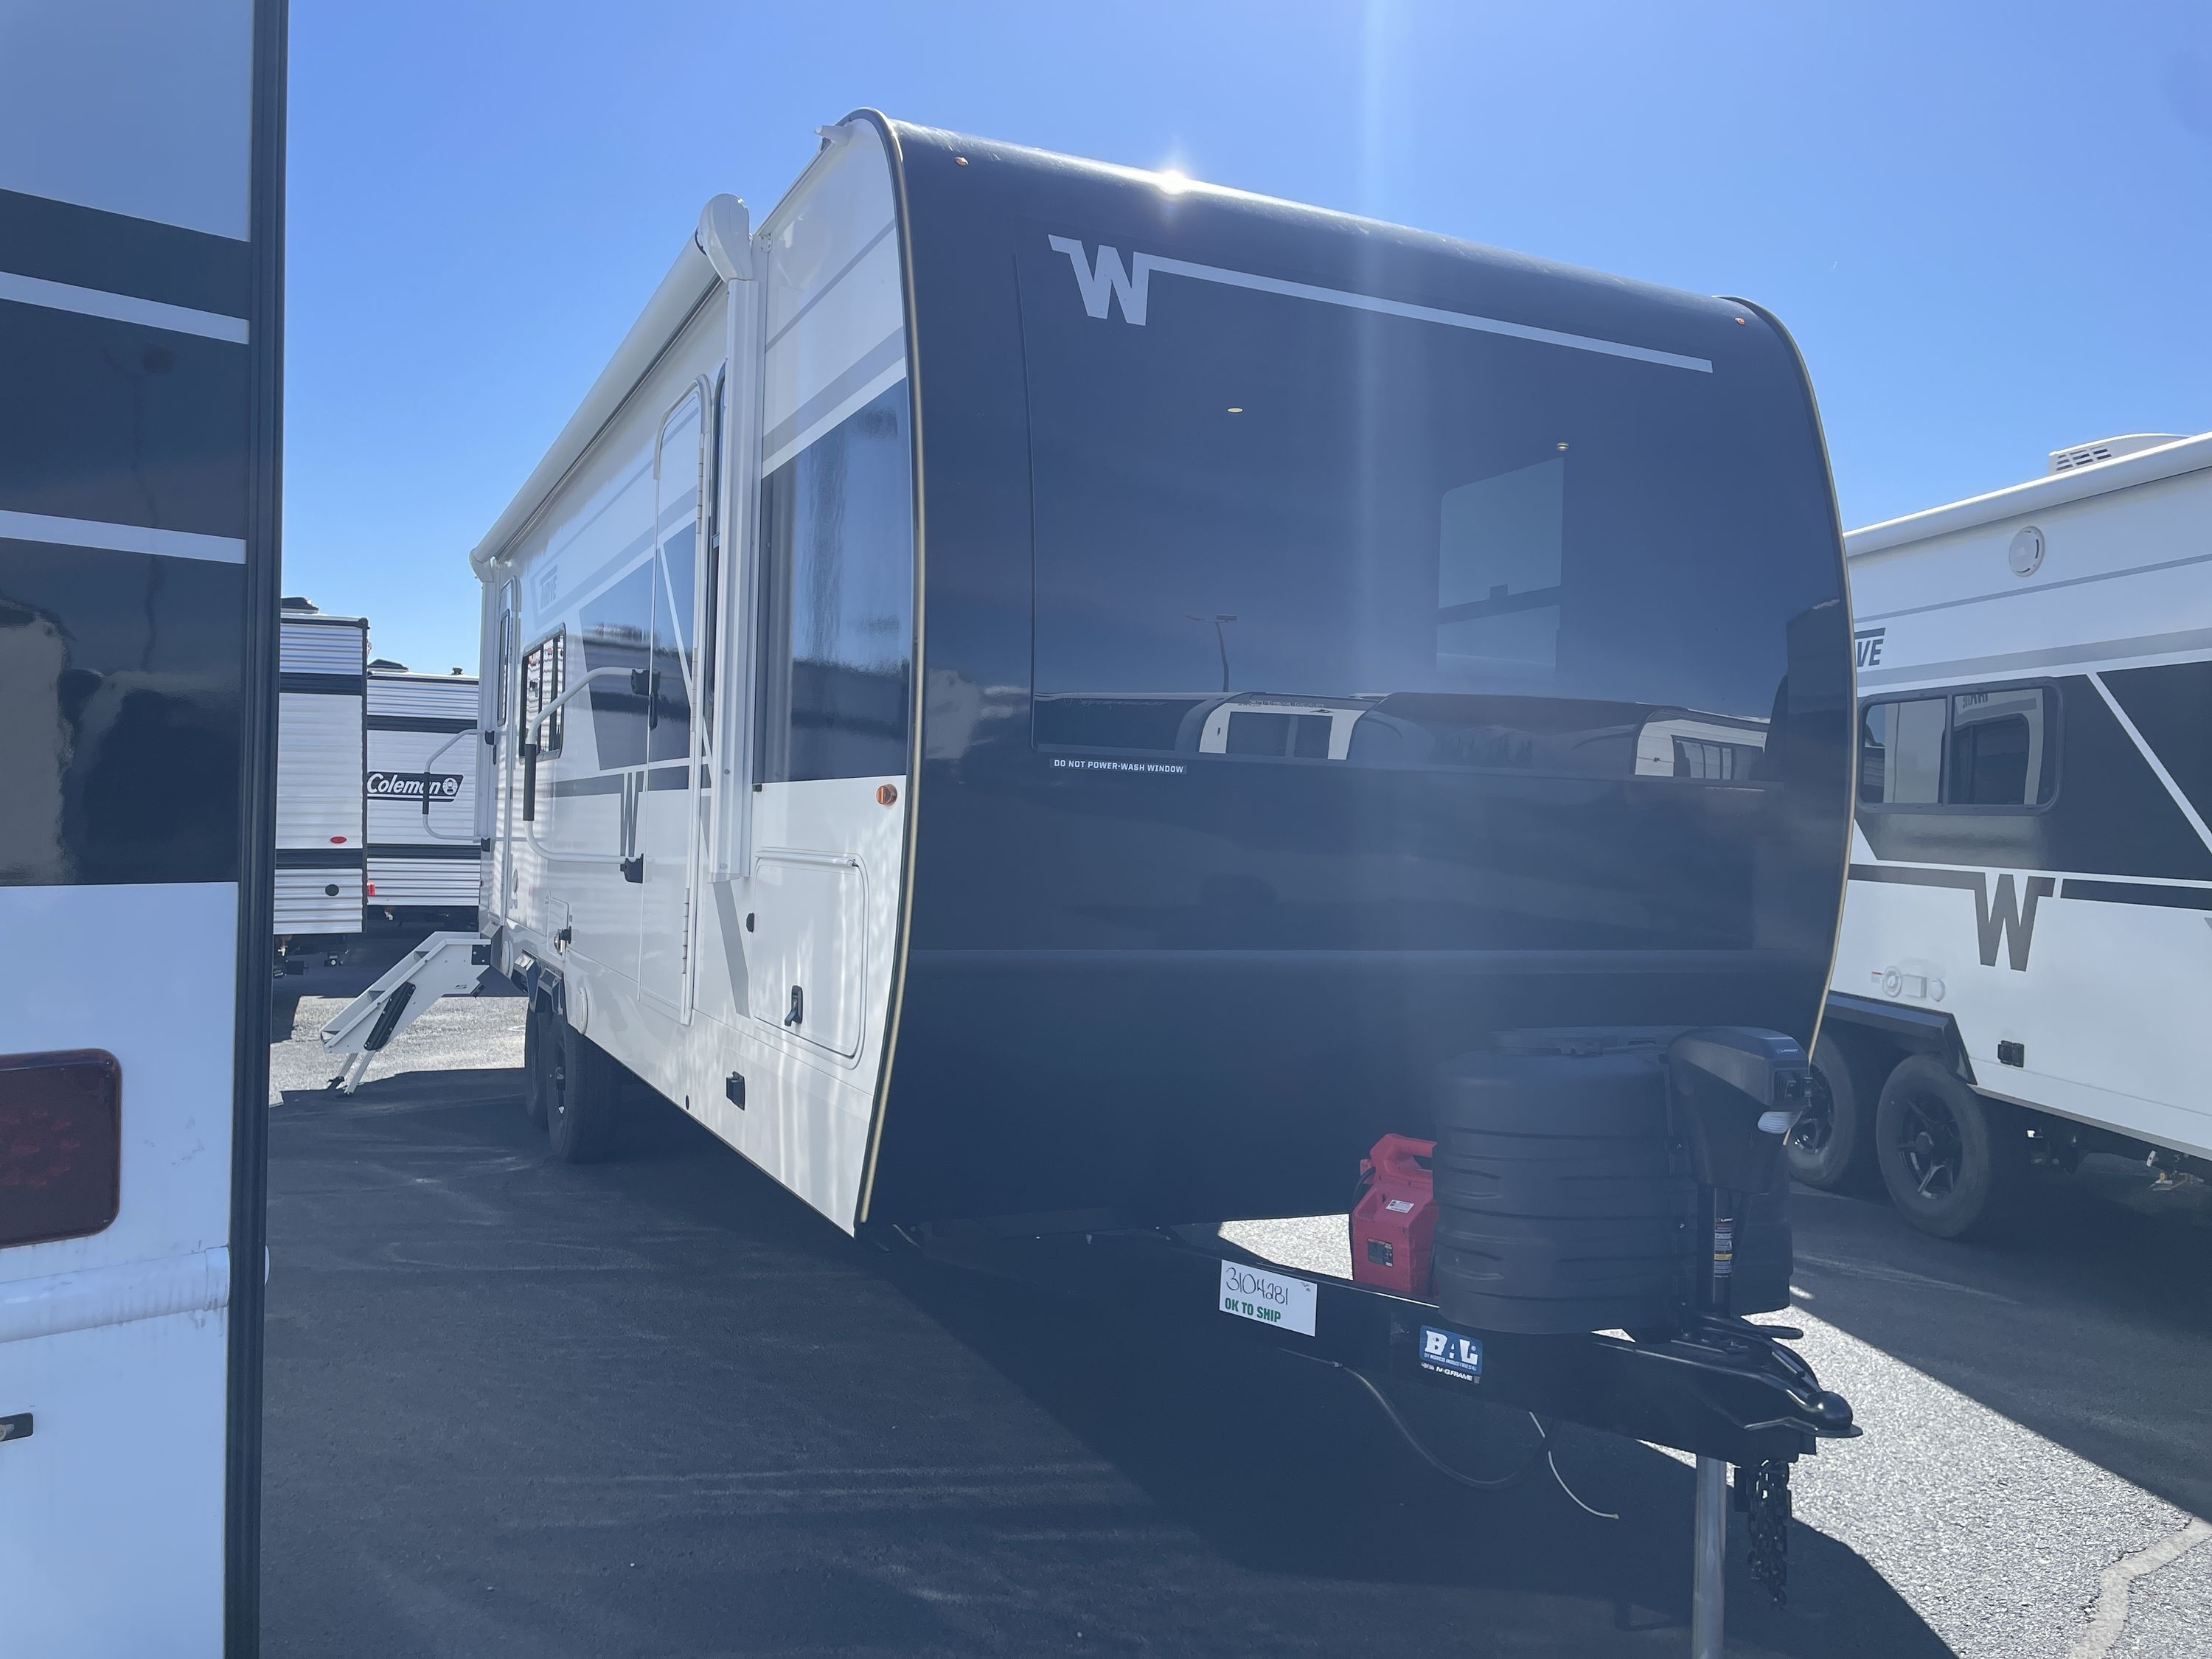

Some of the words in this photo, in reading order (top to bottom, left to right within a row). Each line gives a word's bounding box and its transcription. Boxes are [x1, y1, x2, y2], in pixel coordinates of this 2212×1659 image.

[1048, 233, 1150, 327] W
[1054, 759, 1066, 767] DO
[1068, 759, 1086, 768] NOT
[1088, 761, 1145, 771] POWER-WASH
[1147, 764, 1183, 773] WINDOW
[1974, 872, 2056, 972] W
[1225, 1267, 1289, 1306] 3104281
[1225, 1297, 1240, 1312] OK
[1241, 1301, 1254, 1316] TO
[1256, 1306, 1281, 1323] SHIP
